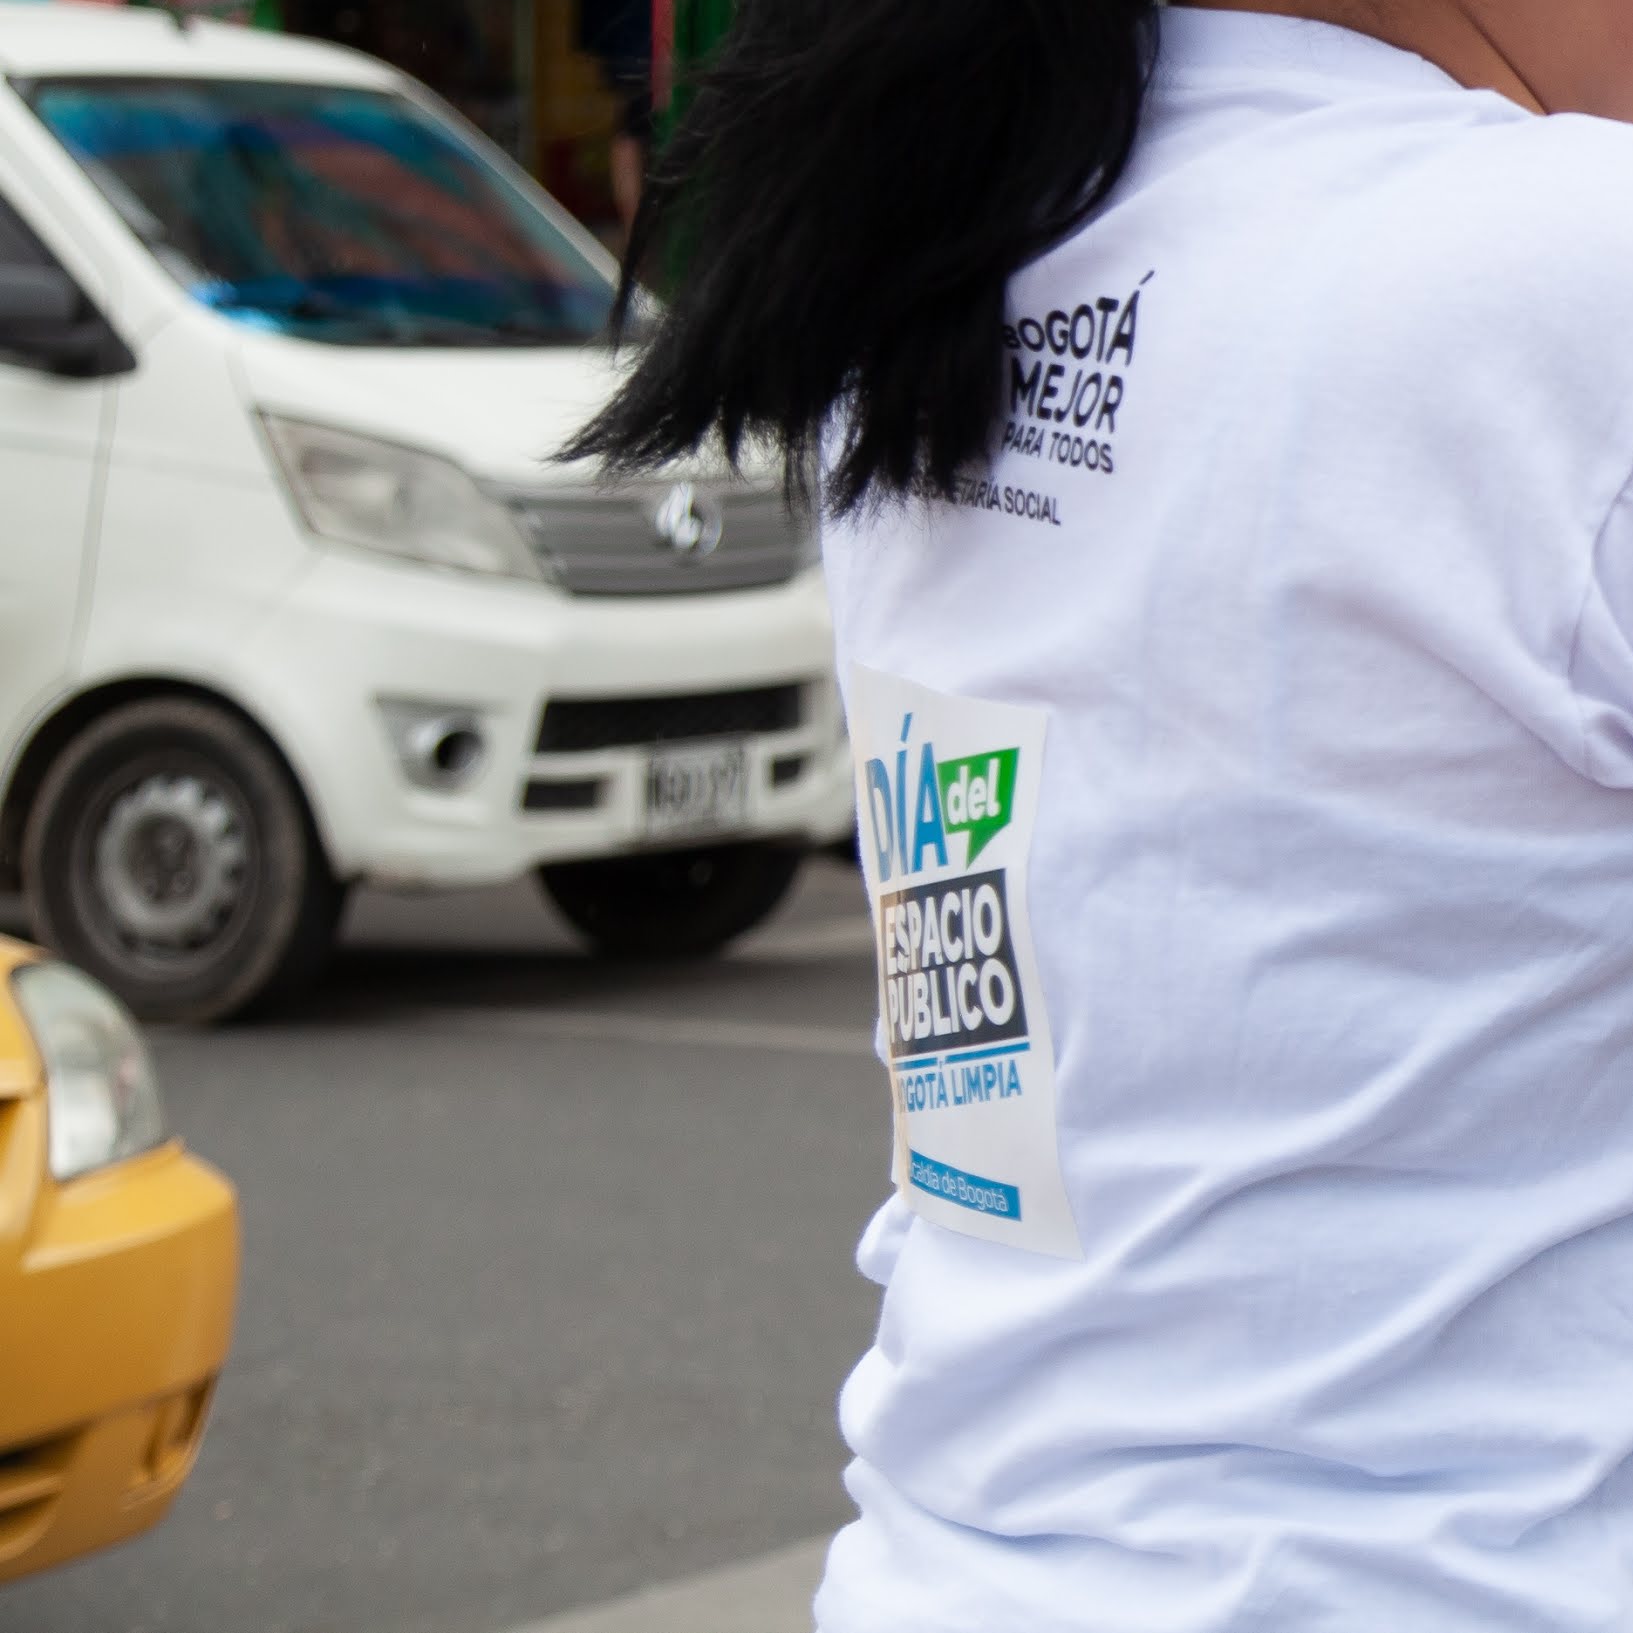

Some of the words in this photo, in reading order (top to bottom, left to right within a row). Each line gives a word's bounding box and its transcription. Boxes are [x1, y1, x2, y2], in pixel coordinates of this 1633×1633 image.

[1010, 355, 1124, 434] MEJOR
[1001, 421, 1045, 459] PARA
[1050, 431, 1114, 475] TODOS
[1004, 485, 1061, 526] SOCIAL
[865, 711, 949, 882] DÍA
[945, 757, 1001, 826] del
[885, 884, 1003, 975] ESPACIO
[952, 1059, 1022, 1107] LIMPIA
[942, 1171, 958, 1197] de
[958, 1176, 1009, 1213] Bogotá
